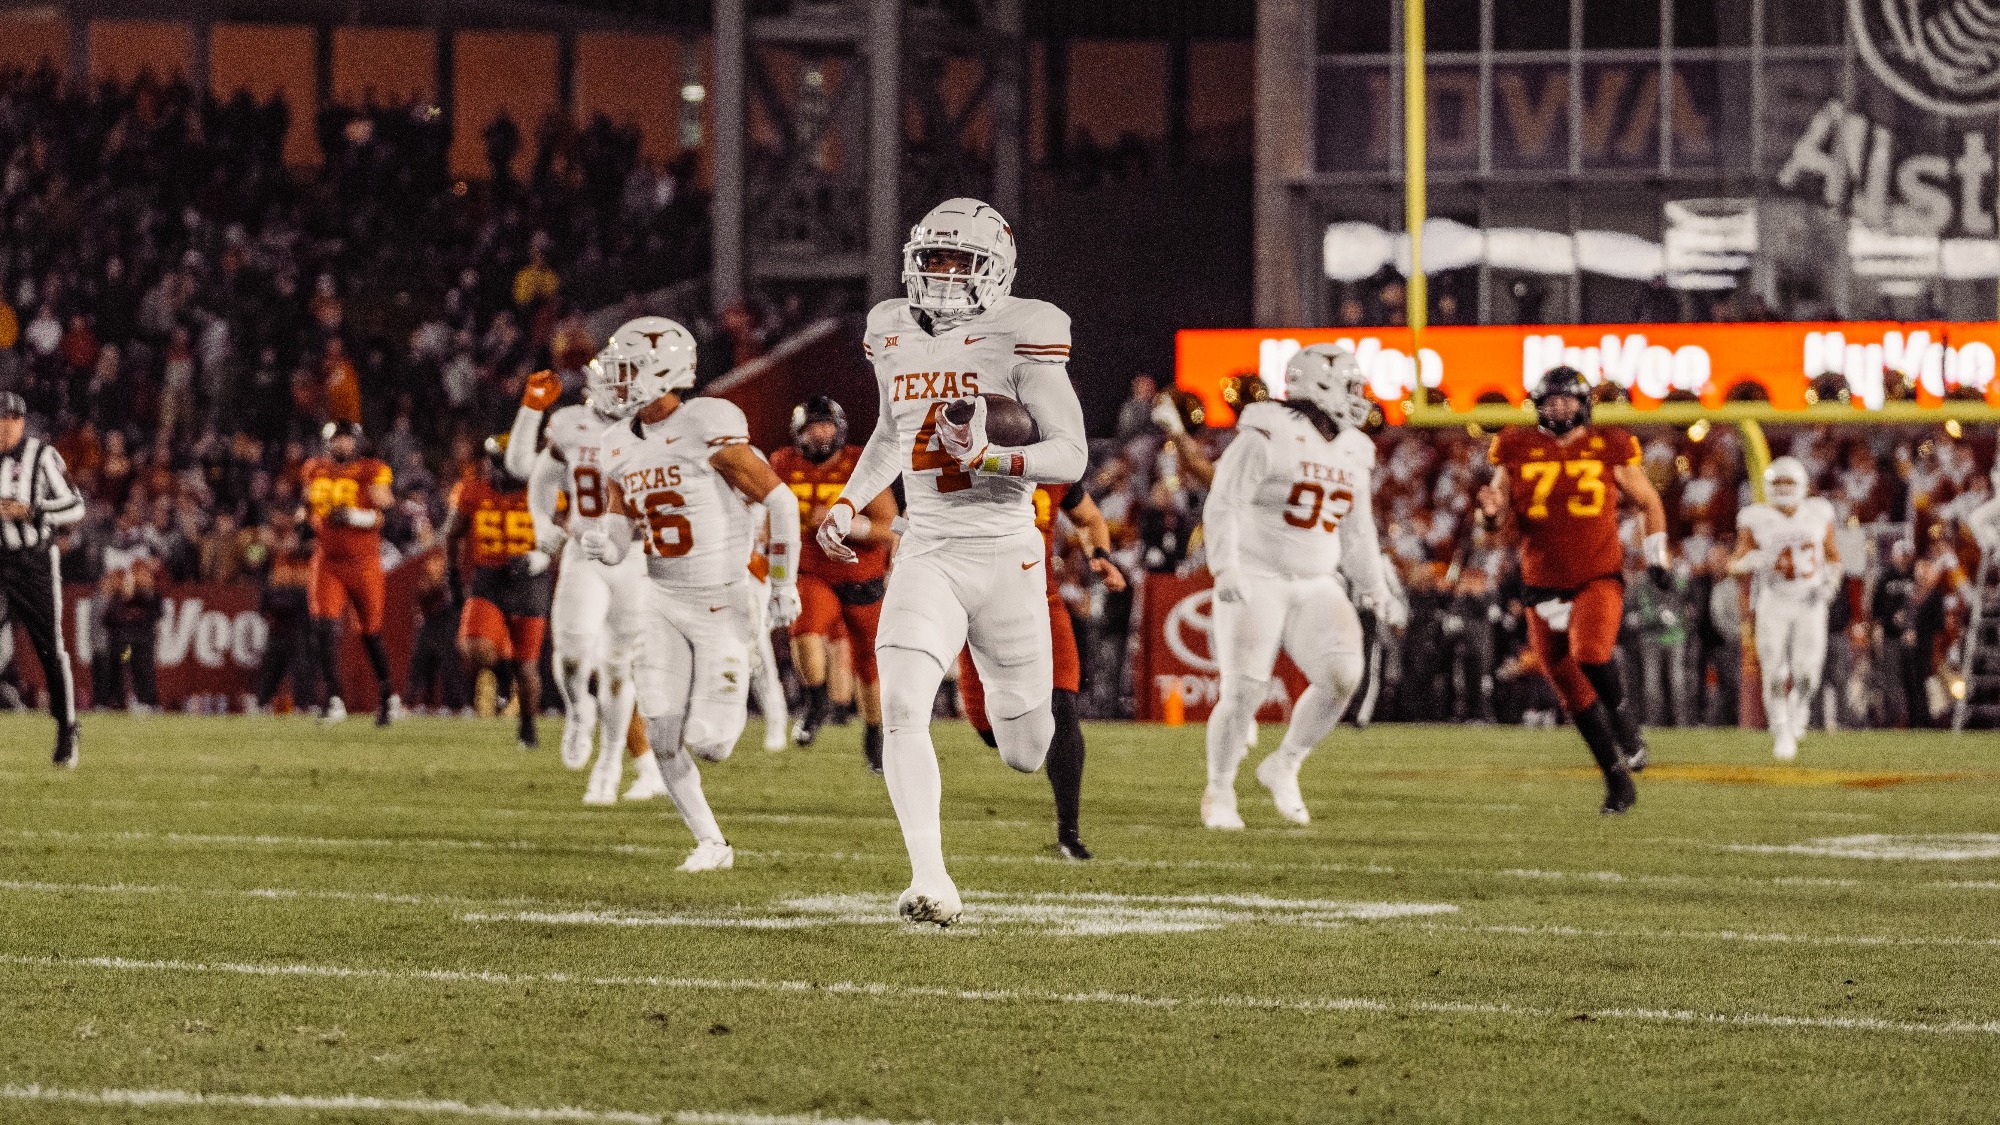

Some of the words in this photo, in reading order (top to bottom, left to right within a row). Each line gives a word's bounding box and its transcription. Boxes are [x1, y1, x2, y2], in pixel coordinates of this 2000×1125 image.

[1368, 71, 1713, 157] IOWA
[893, 371, 980, 401] TEXAS
[911, 402, 973, 493] 4
[1520, 459, 1607, 519] 73
[474, 510, 536, 555] 55
